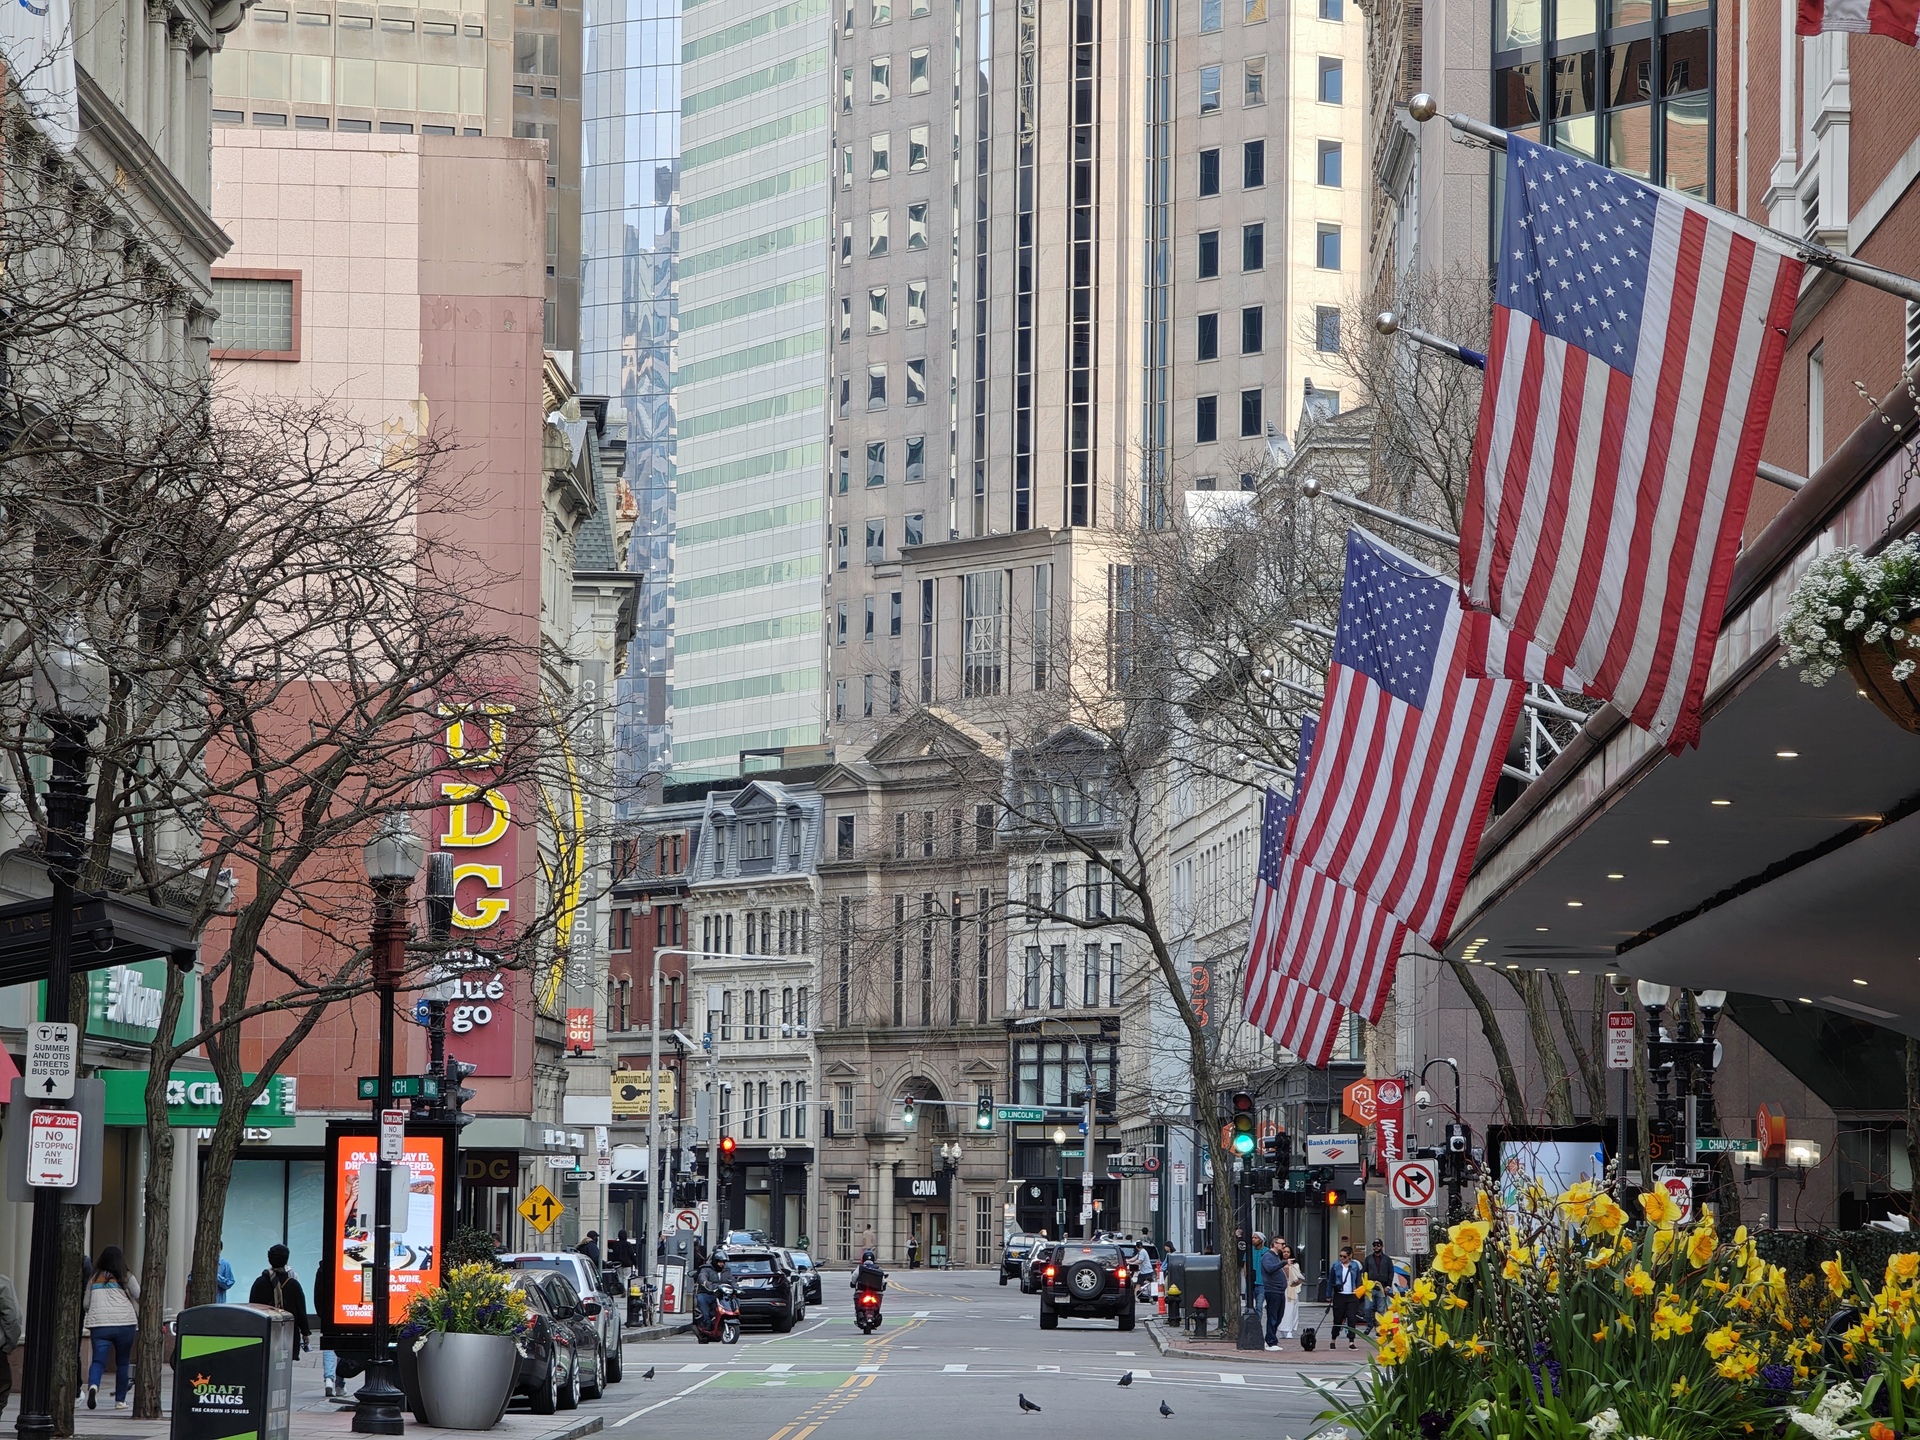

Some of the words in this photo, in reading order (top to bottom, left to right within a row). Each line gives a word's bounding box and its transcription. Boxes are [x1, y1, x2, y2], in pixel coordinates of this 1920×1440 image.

[580, 679, 596, 818] conseraon
[5, 906, 83, 934] TRET
[452, 1005, 492, 1033] go
[569, 1014, 591, 1029] clf.
[1610, 1016, 1620, 1026] TOW
[1620, 1016, 1633, 1026] ZONE
[569, 1029, 591, 1042] org
[1616, 1030, 1626, 1038] NO
[34, 1043, 70, 1052] SUMMER
[33, 1052, 50, 1060] AND
[52, 1052, 70, 1061] OTIS
[33, 1060, 69, 1068] STREETS
[31, 1067, 48, 1075] BUS
[49, 1068, 70, 1076] STOP
[612, 1072, 641, 1084] Downtown
[642, 1072, 671, 1084] Lomith
[1355, 1090, 1367, 1099] 71
[1007, 1111, 1034, 1119] LINCOLN
[34, 1115, 53, 1125] TOW
[55, 1117, 77, 1126] ZONE
[45, 1131, 64, 1141] NO
[34, 1141, 74, 1150] STOPPING
[1708, 1139, 1741, 1150] CHAUNCY
[44, 1150, 62, 1158] ANY
[350, 1152, 369, 1163] OK,
[401, 1152, 417, 1161] SAY
[418, 1152, 430, 1161] IT:
[43, 1157, 63, 1166] TIME
[911, 1180, 938, 1196] CAVA
[397, 1274, 422, 1284] WINE,
[359, 1303, 374, 1311] DOO
[193, 1383, 246, 1395] DRAFT
[199, 1393, 244, 1405] KINGS
